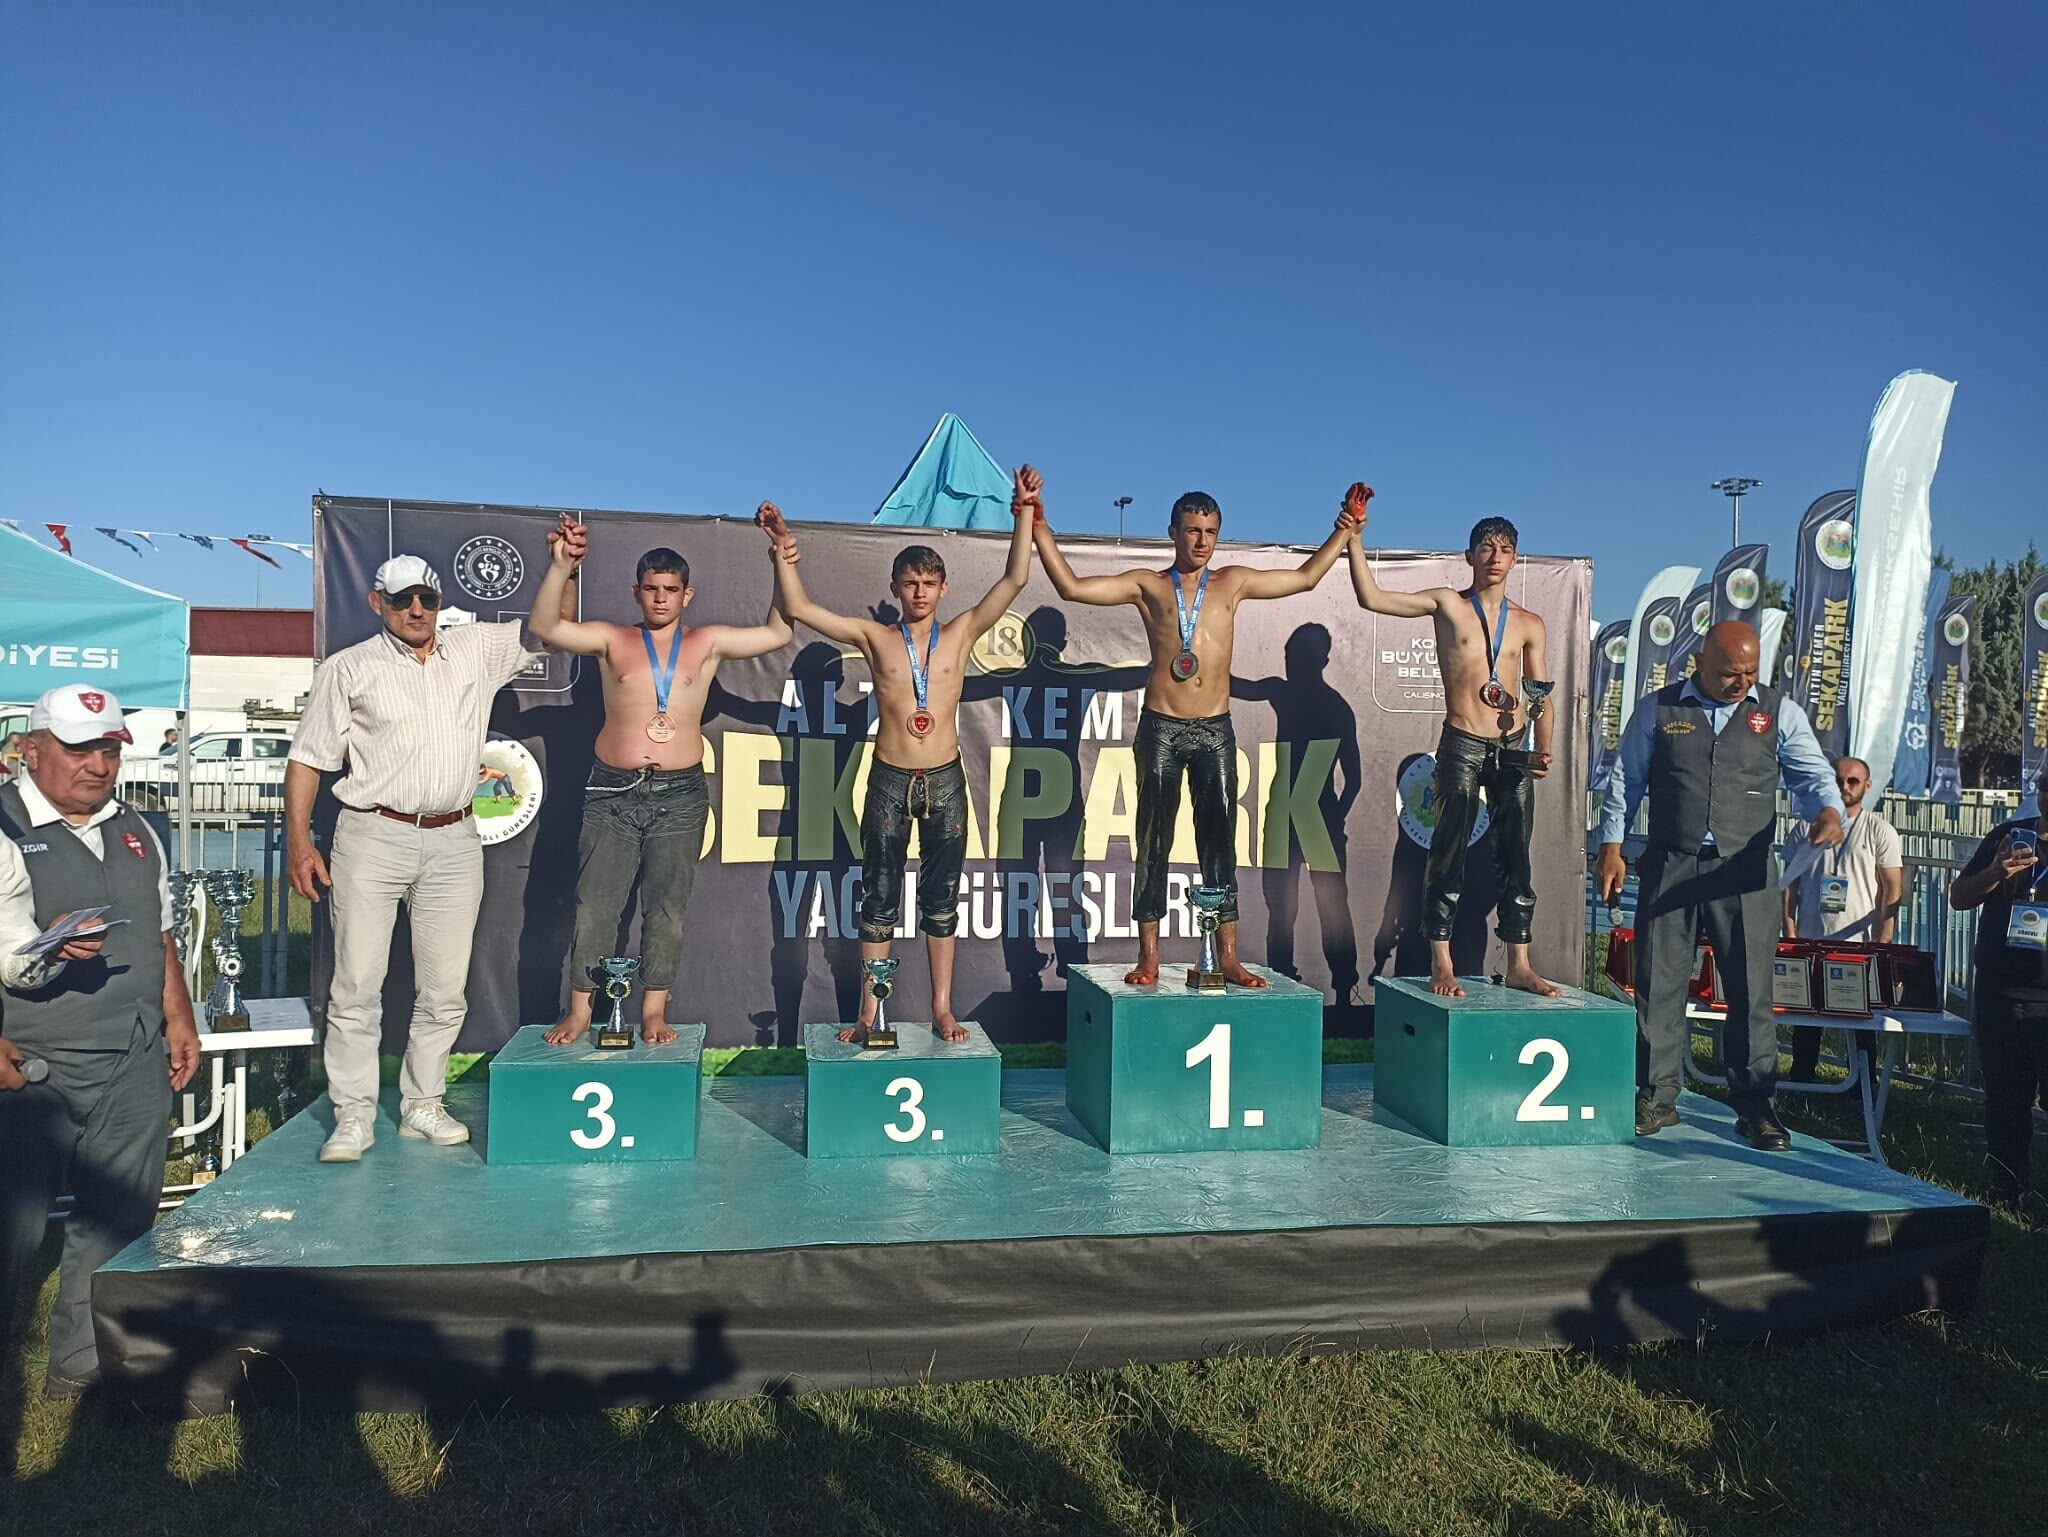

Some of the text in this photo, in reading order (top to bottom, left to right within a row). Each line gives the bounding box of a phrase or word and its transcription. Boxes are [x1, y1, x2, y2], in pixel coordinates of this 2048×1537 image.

[1815, 597, 1849, 731] SEKAPARK
[1944, 663, 1959, 749] SEKAPARK
[570, 1080, 635, 1150] 3.
[882, 1077, 944, 1143] 3.
[1186, 1023, 1264, 1128] 1.
[1516, 1038, 1595, 1122] 2.
